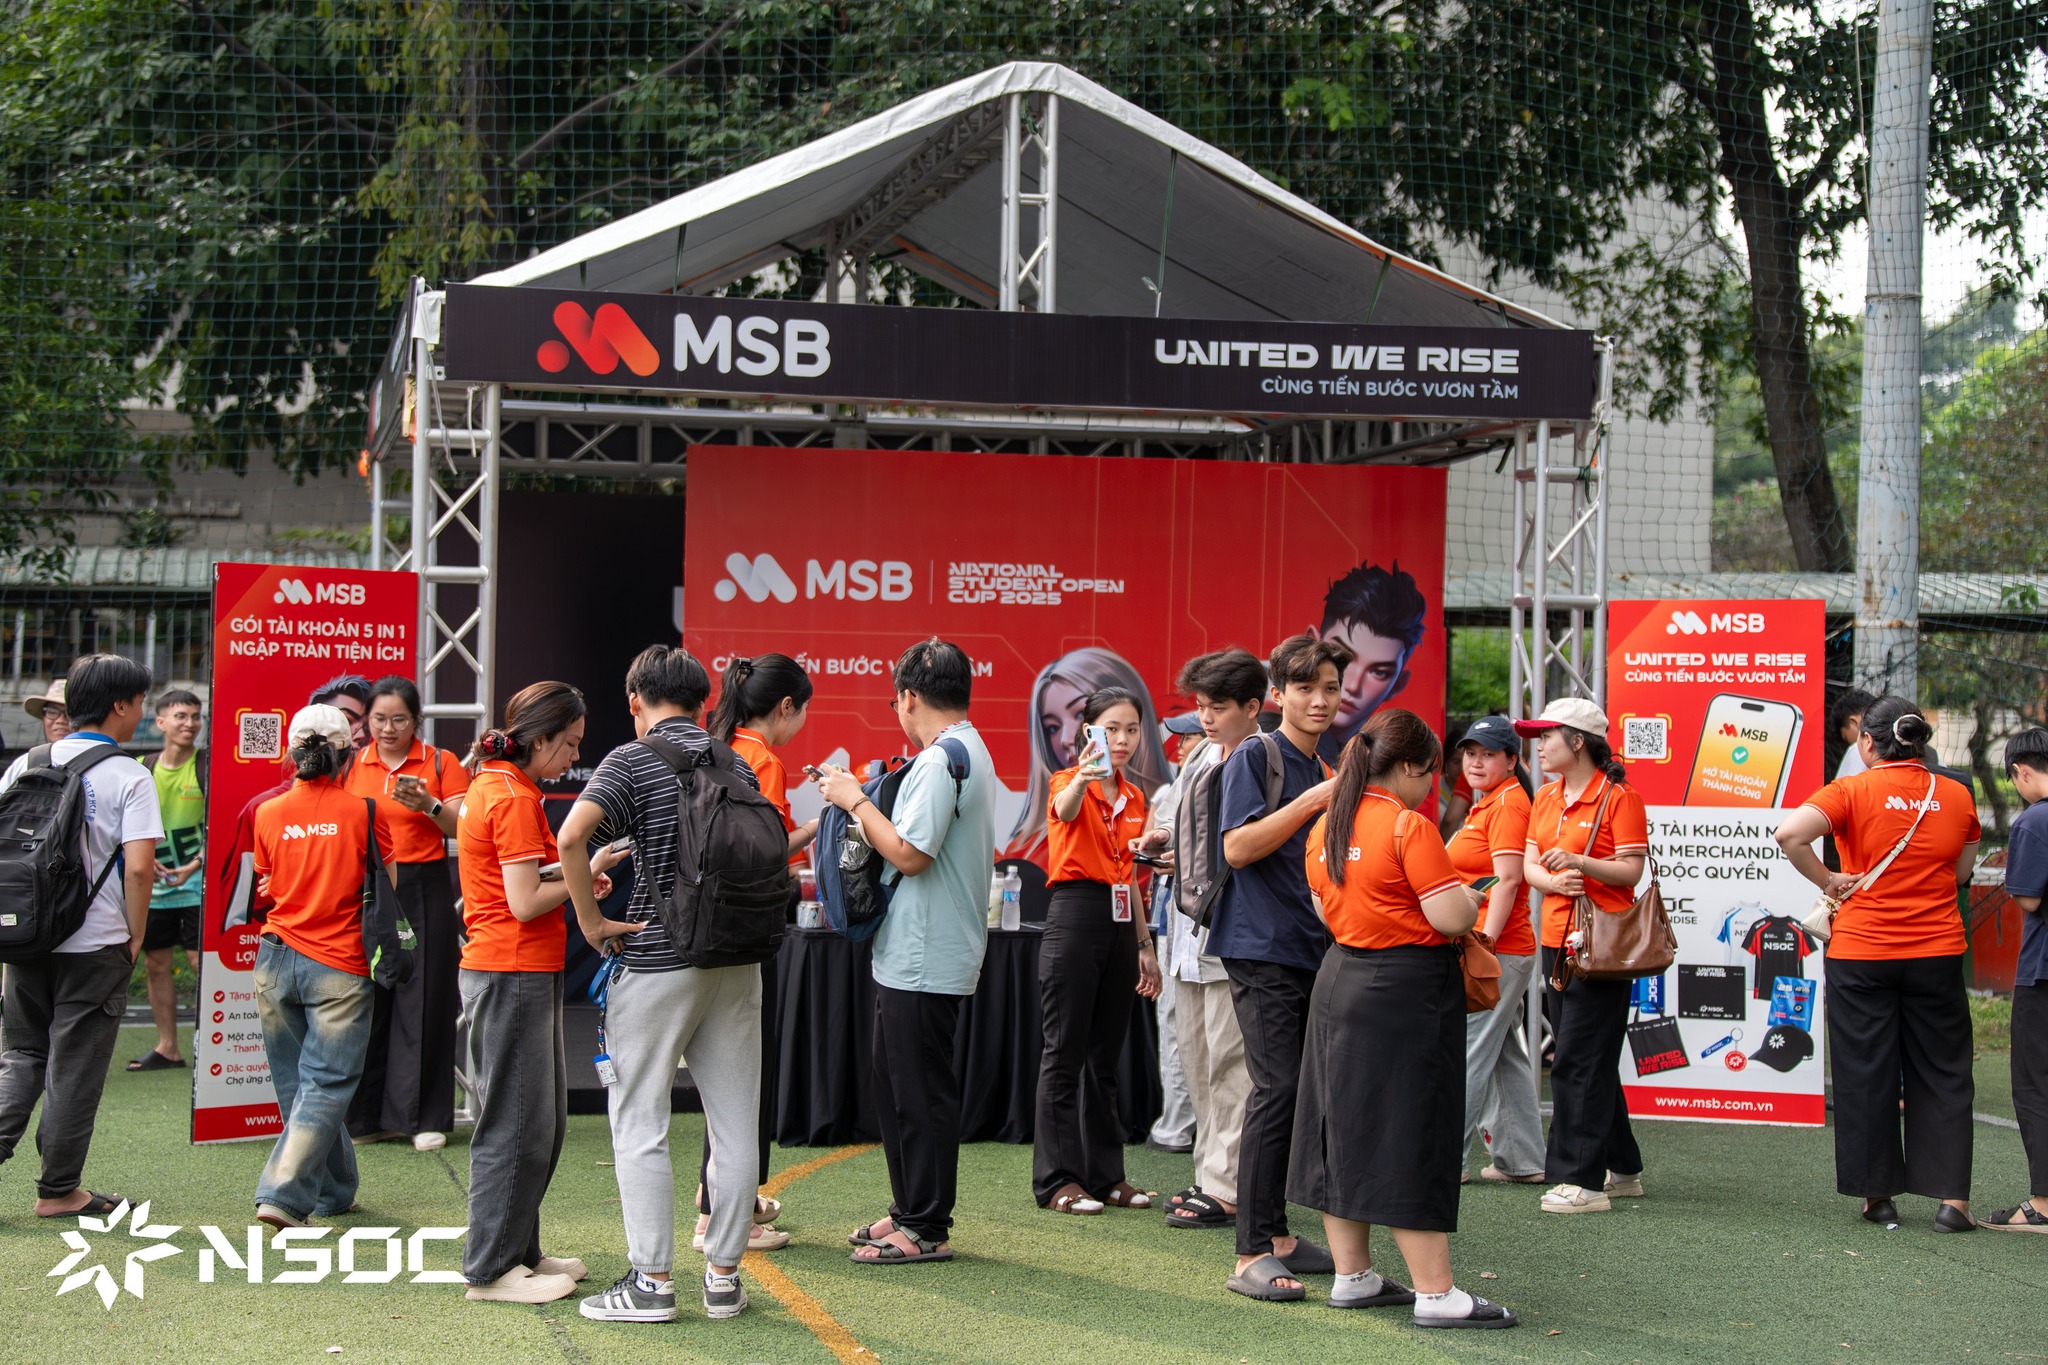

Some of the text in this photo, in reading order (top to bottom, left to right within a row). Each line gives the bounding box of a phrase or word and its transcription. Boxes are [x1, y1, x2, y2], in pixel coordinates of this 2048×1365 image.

[673, 312, 832, 378] MSB
[1155, 338, 1520, 374] UNITED WE RISE
[1261, 375, 1519, 400] CÙNG TIẾN BƯỚC VƯƠN TẦM
[949, 562, 1065, 579] NATIONAL
[805, 558, 914, 602] MSB
[948, 576, 1126, 594] STUDENT OPEN
[316, 582, 366, 605] MSB
[947, 589, 1063, 606] CUP 2025
[230, 615, 406, 640] GÓI TÀI KHOẢN 5 IN 1
[1710, 612, 1765, 633] MSB
[229, 637, 405, 664] NGẬP TRÀN TIỆN ÍCH
[826, 655, 883, 675] BƯỚC
[1624, 652, 1807, 667] UNITED WE RISE
[1624, 668, 1806, 684] CÙNG TIẾN BƯỚC VƯƠN TẦM
[1740, 727, 1769, 743] MSB
[1702, 766, 1768, 789] MỞ TÀI KHOẢN
[1702, 778, 1762, 800] THÀNH CÔNG
[1909, 798, 1941, 812] MB
[307, 823, 338, 836] MSB
[1660, 820, 1687, 837] TÀI
[1693, 821, 1759, 838] KHOẢN
[1659, 861, 1769, 882] ĐỘC QUYỀN
[1763, 941, 1795, 951] NSOC
[236, 949, 256, 965] LỢI
[229, 991, 251, 1002] Tặng
[1648, 975, 1658, 1003] SOC
[228, 1012, 241, 1021] An
[227, 1032, 245, 1043] Một
[233, 1043, 260, 1053] Thanh
[1639, 1049, 1682, 1066] UNITED
[1639, 1056, 1688, 1075] WE RISE
[226, 1063, 244, 1075] Đặc
[225, 1076, 244, 1087] Chợ
[246, 1074, 263, 1084] ứng
[1655, 1096, 1774, 1112] www.msb.com.vn
